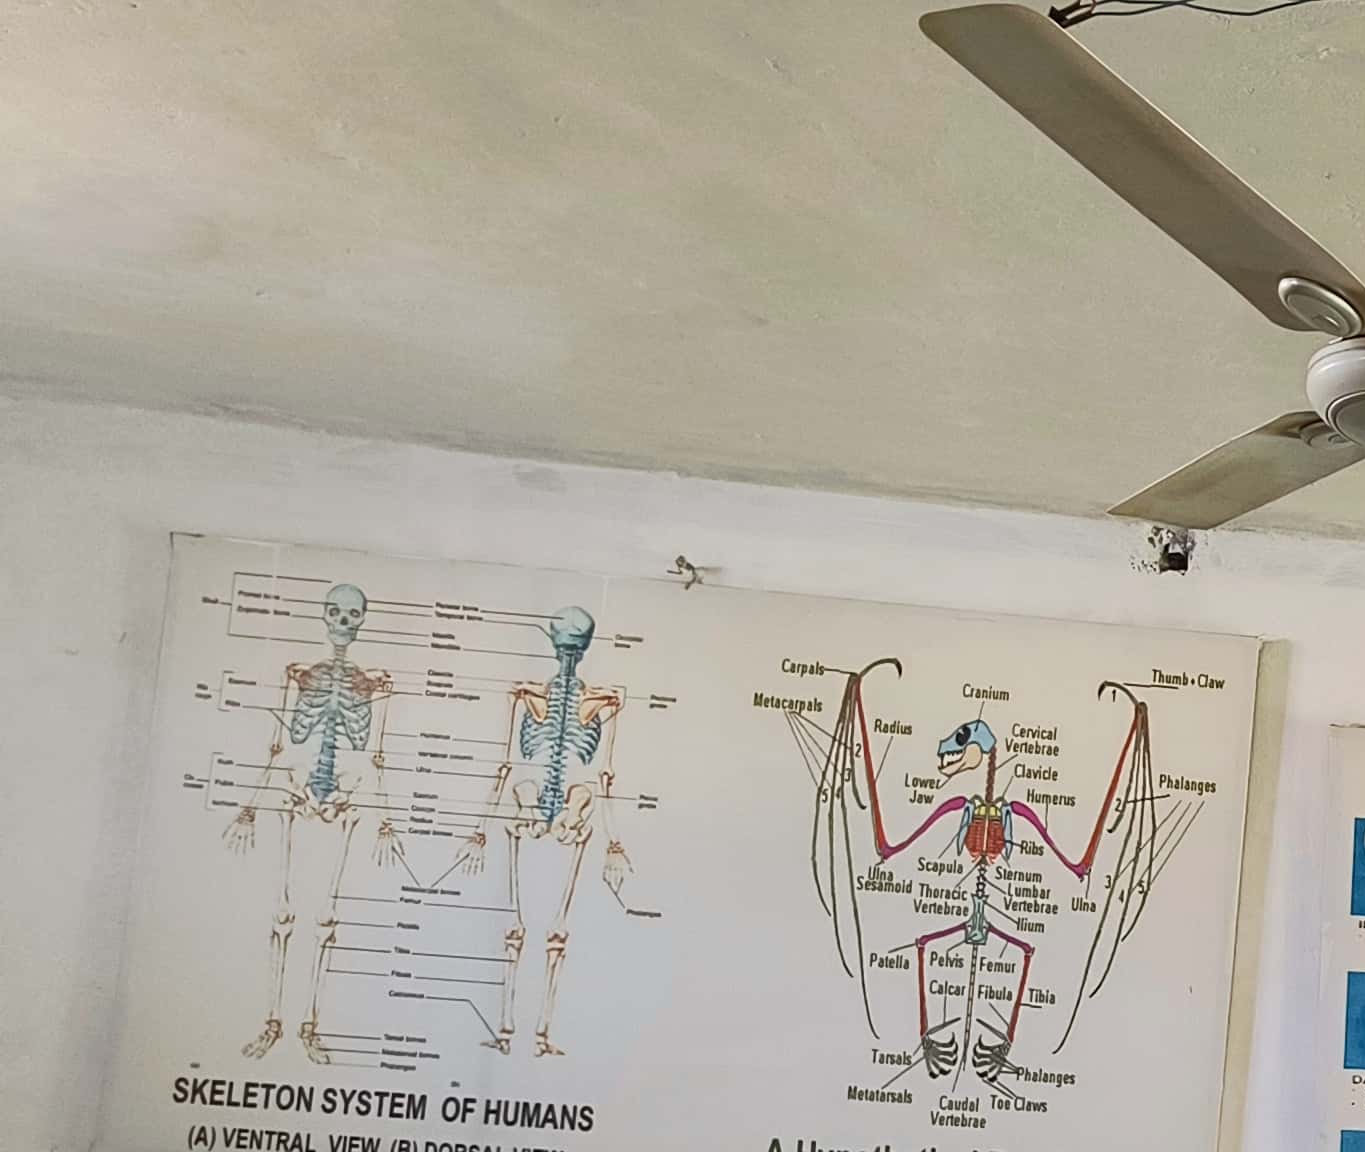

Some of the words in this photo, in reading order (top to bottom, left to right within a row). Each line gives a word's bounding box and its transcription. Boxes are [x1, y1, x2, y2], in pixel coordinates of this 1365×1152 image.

[782, 659, 824, 676] Carpals
[1152, 669, 1189, 686] Thumb
[1198, 674, 1225, 689] Claw
[963, 684, 1009, 701] Cranium
[754, 693, 823, 712] Metacarpals
[874, 719, 912, 735] Radius
[1012, 723, 1057, 740] Cervical
[1005, 738, 1059, 756] Vertebrae
[905, 773, 940, 789] Lower
[1014, 764, 1058, 781] Clavicle
[1159, 774, 1216, 795] Phalanges
[910, 792, 934, 804] Jaw
[1027, 789, 1076, 807] Humerus
[1020, 841, 1044, 856] Ribs
[868, 867, 893, 882] Ulna
[918, 858, 963, 876] Scapula
[995, 867, 1042, 882] Sternum
[856, 876, 912, 894] Sesamoid
[919, 883, 967, 900] Thoracic
[1008, 883, 1050, 899] Lumbar
[913, 900, 969, 916] Vertebrae
[1003, 899, 1058, 915] Vertebrae
[1072, 897, 1096, 912] Ulna
[1017, 917, 1045, 933] Ilium
[870, 953, 910, 969] Patella
[930, 951, 964, 968] Pelvis
[979, 957, 1016, 973] Femur
[929, 980, 965, 996] Calcar
[978, 985, 1013, 1001] Fibula
[1028, 988, 1055, 1004] Tibia
[872, 1049, 912, 1066] Tarsals
[1017, 1067, 1076, 1087] Phalanges
[847, 1086, 912, 1103] Metatarsals
[173, 1077, 314, 1112] SKELETON
[321, 1088, 427, 1120] SYSTEM
[441, 1097, 476, 1123] OF
[483, 1099, 594, 1132] HUMANS
[939, 1096, 979, 1112] Caudal
[990, 1095, 1010, 1110] Toe
[1014, 1097, 1047, 1112] Claws
[931, 1112, 986, 1128] Vertebrae
[188, 1126, 216, 1151] (A)
